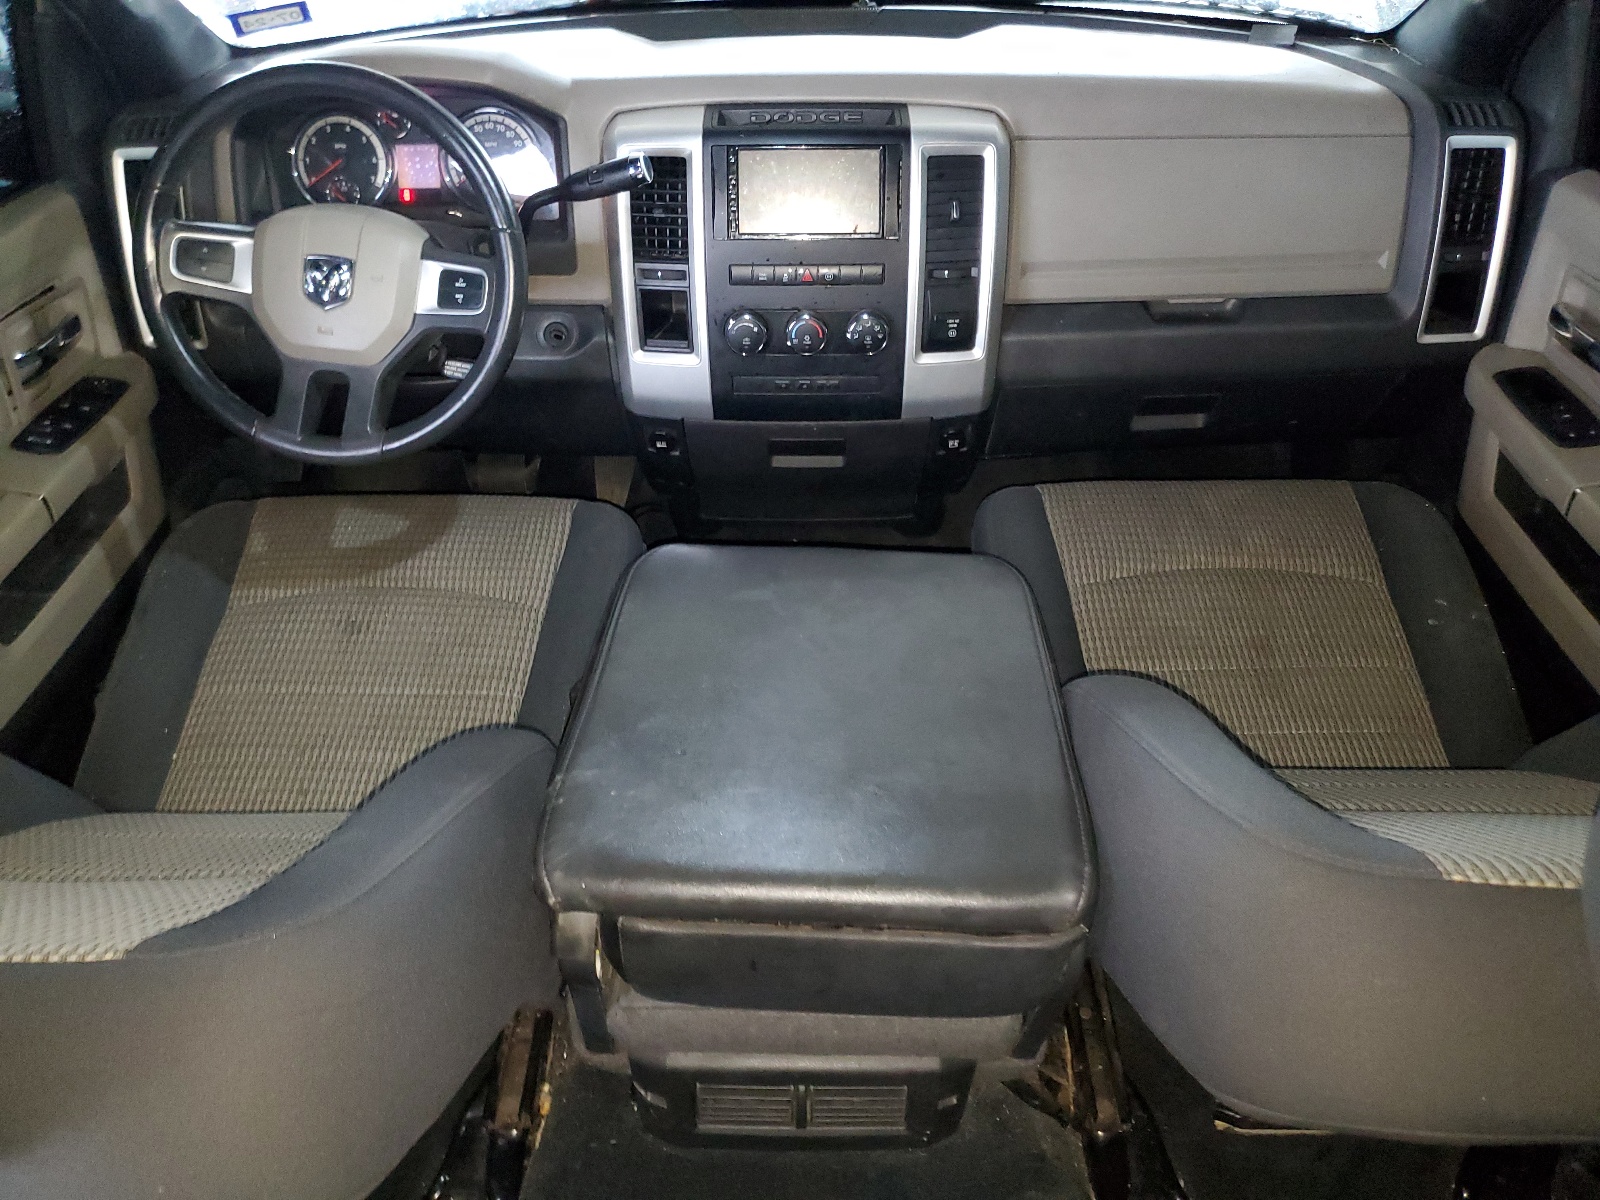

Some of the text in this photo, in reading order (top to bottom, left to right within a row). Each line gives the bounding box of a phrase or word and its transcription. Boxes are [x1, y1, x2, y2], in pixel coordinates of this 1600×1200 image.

[750, 110, 863, 124] DODGE
[484, 122, 494, 130] 60
[514, 139, 522, 147] 90
